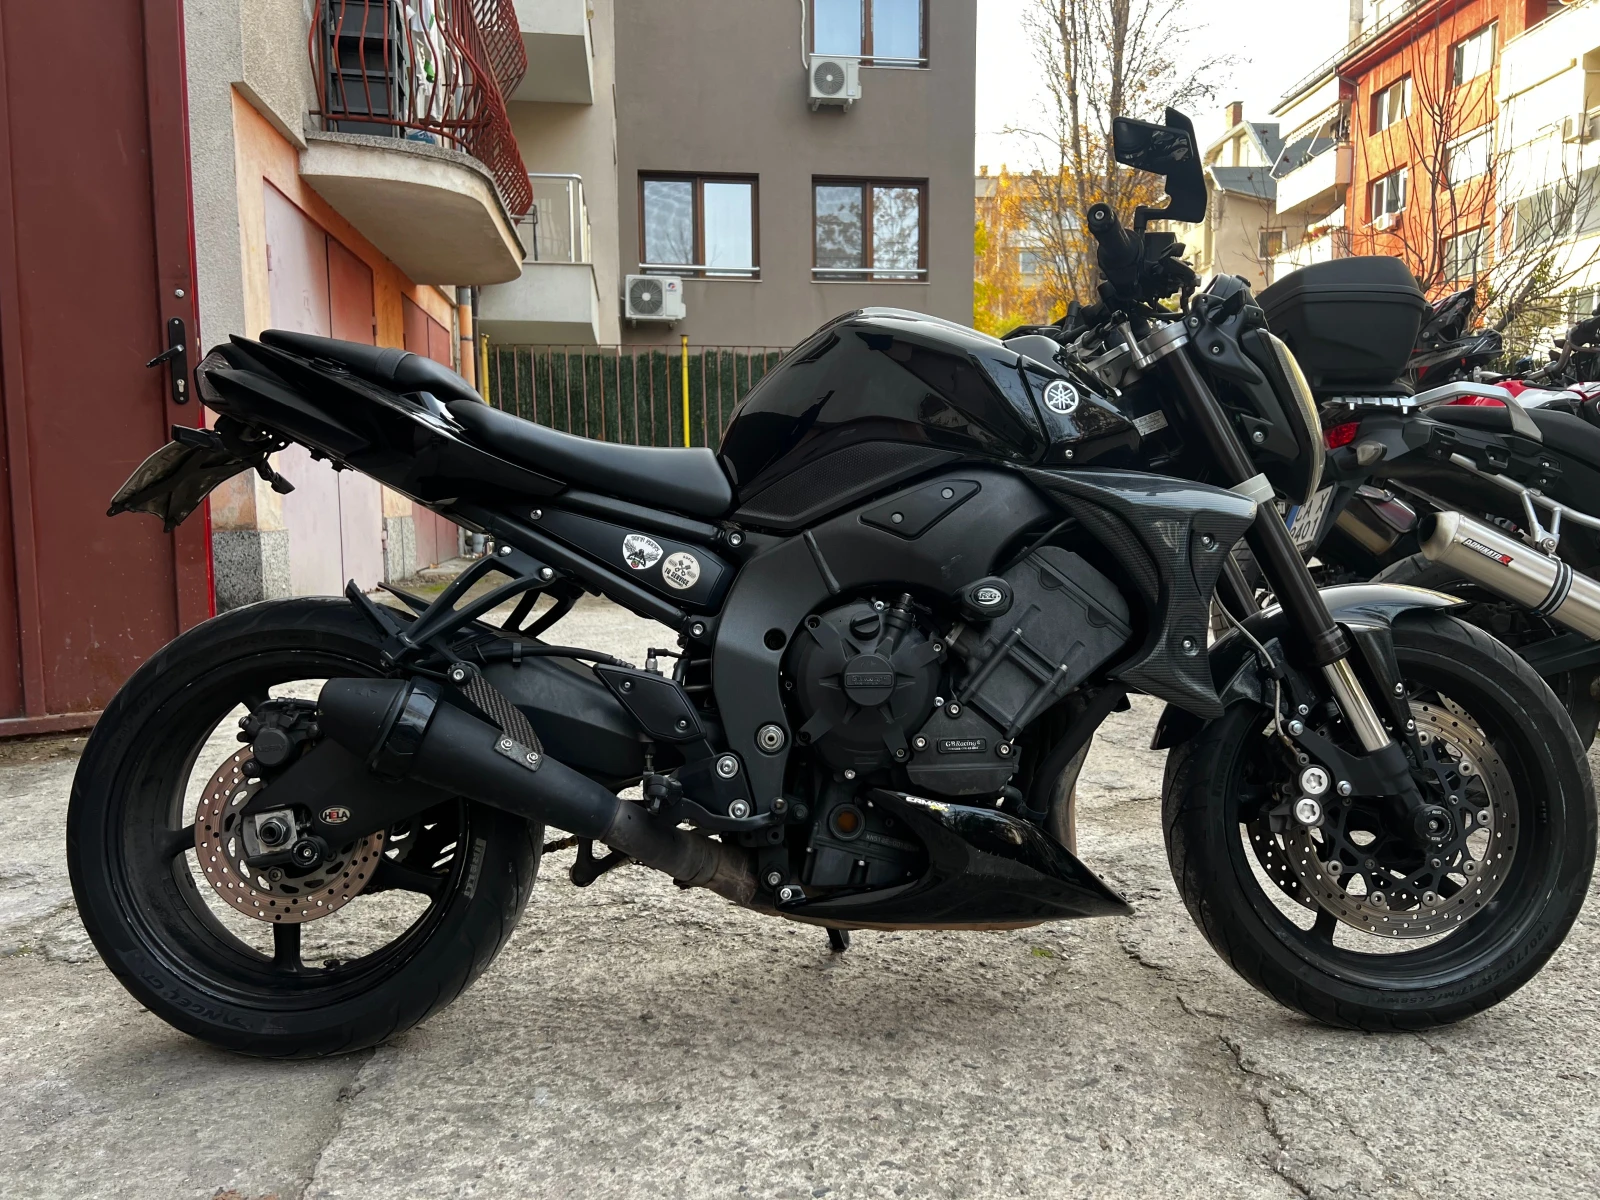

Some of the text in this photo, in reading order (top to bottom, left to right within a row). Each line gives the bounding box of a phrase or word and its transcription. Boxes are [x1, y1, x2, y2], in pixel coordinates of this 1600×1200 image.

[1462, 538, 1512, 566] DOMINATOR
[670, 571, 690, 587] SERVICE
[324, 810, 349, 820] HELA
